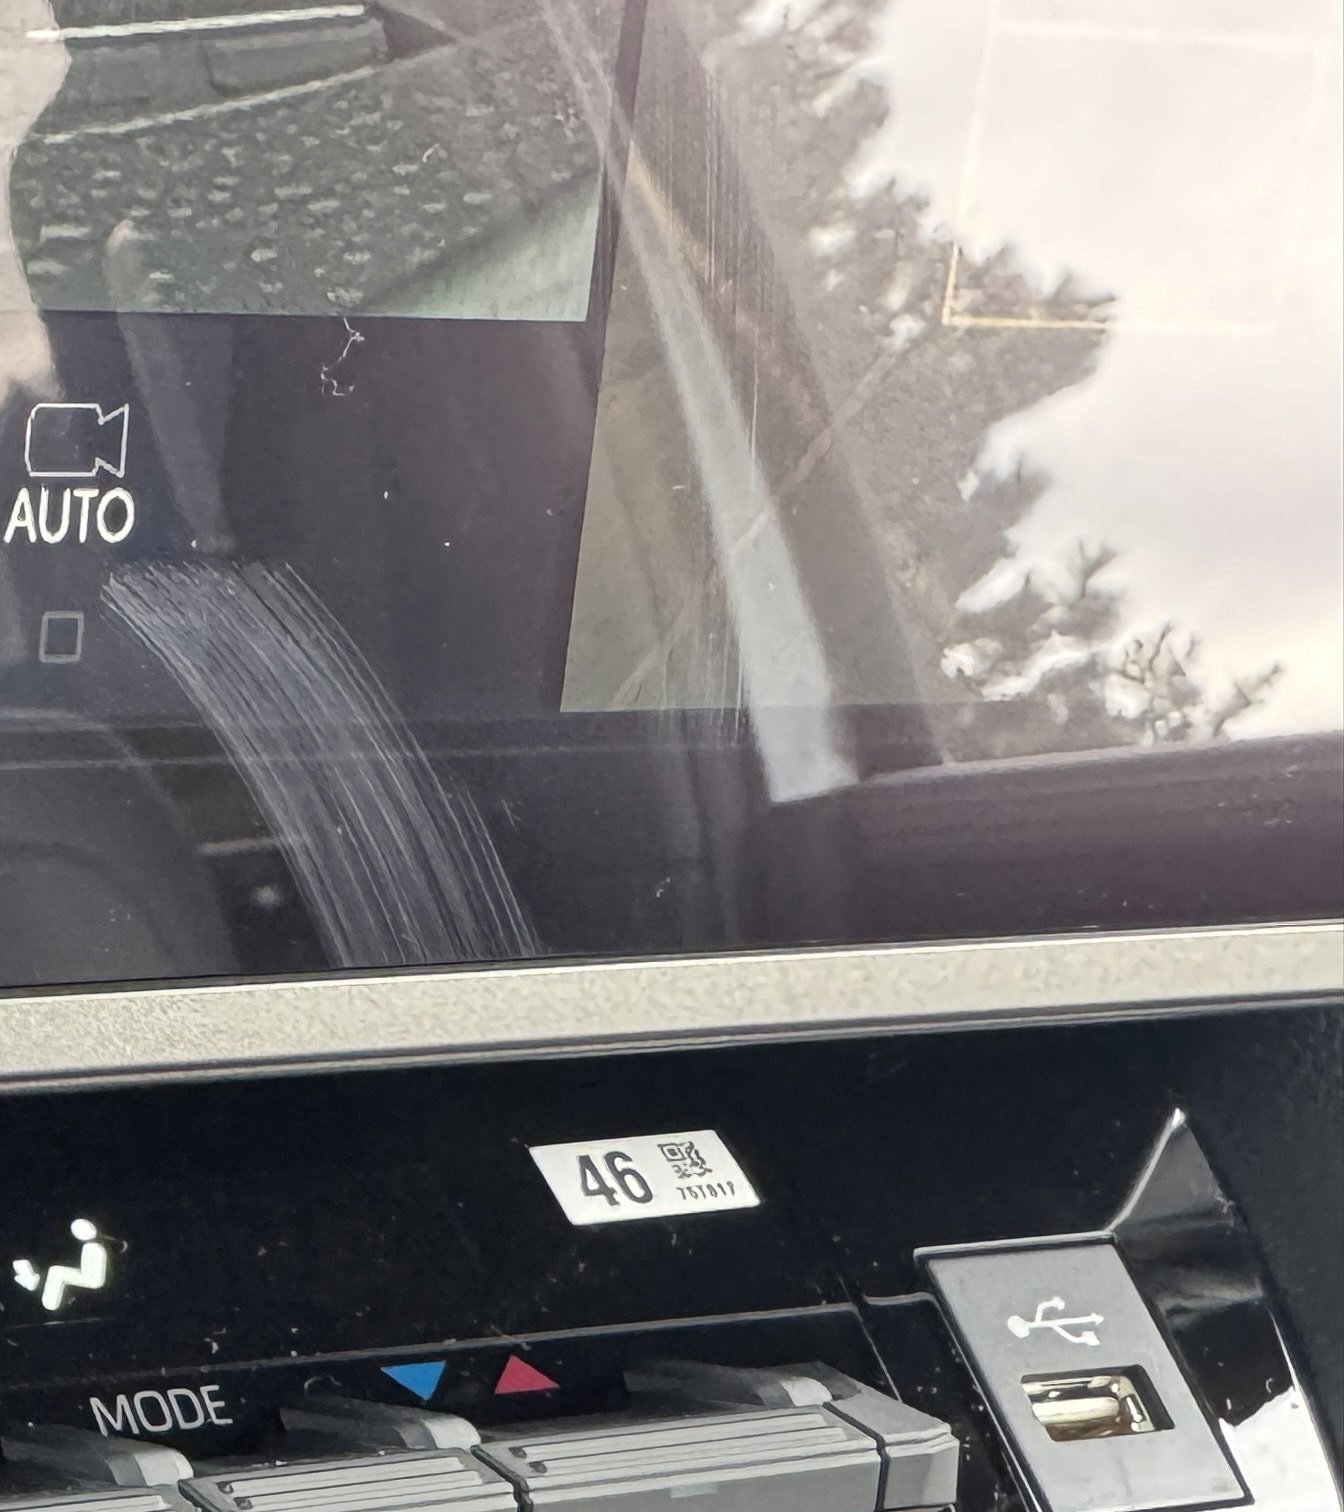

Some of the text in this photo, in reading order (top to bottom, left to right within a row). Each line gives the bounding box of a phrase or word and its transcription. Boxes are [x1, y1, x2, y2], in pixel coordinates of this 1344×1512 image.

[3, 488, 136, 545] AUTO
[577, 1150, 654, 1207] 46
[90, 1383, 234, 1437] MODE
